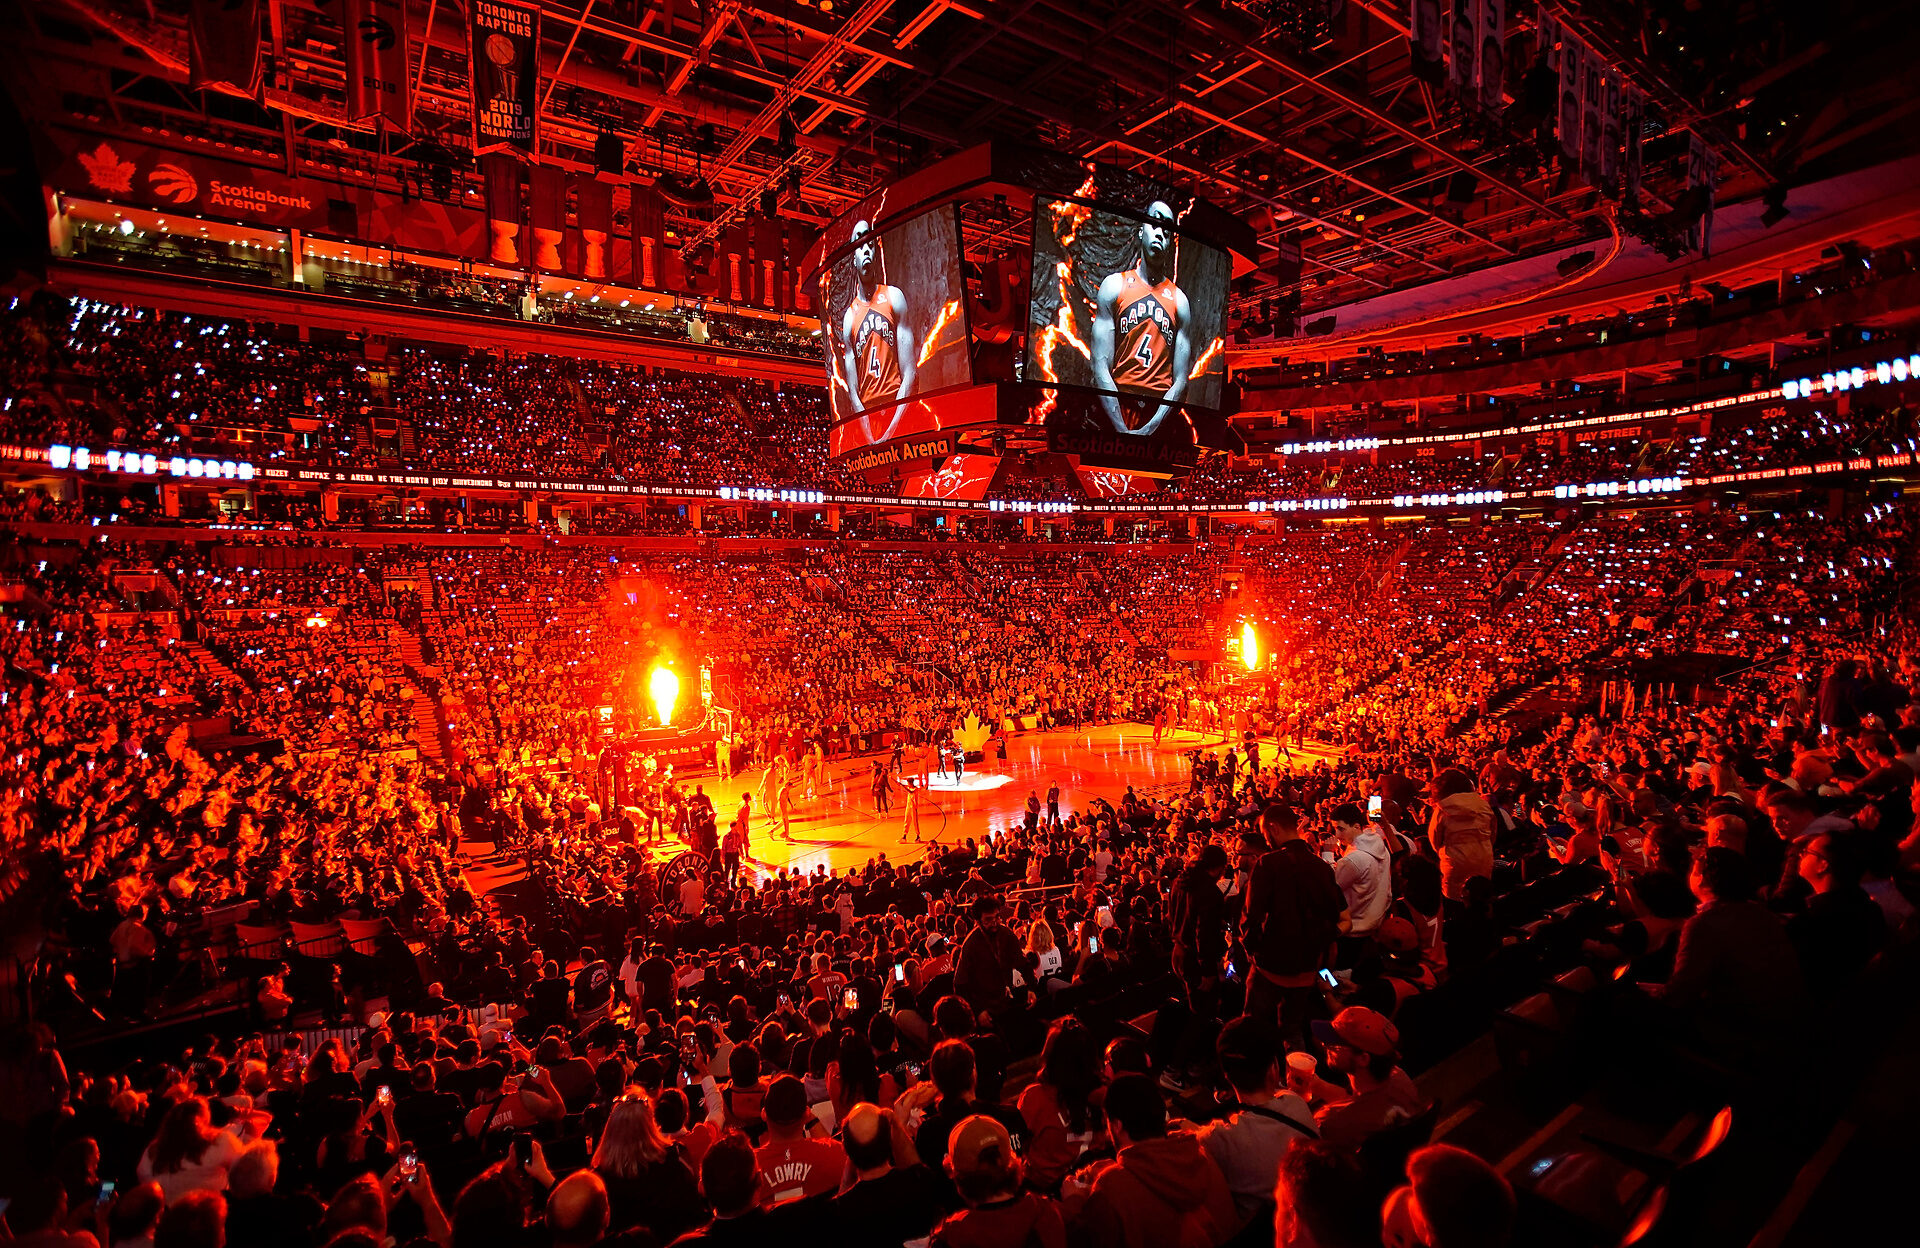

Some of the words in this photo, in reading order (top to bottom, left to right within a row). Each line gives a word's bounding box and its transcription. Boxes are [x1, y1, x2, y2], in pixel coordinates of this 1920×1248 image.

[476, 1, 531, 25] TORONTO
[476, 14, 531, 38] RAPTORS
[489, 98, 523, 116] 2019
[480, 110, 531, 130] WORLD
[480, 124, 531, 139] CHAMPIONS
[211, 180, 311, 210] Scotiabank
[211, 193, 267, 213] Arena
[1119, 301, 1175, 346] RAPTORS
[856, 313, 896, 360] RAPTORS
[869, 345, 882, 378] 4
[1135, 334, 1154, 369] 4
[1056, 431, 1155, 461] Scotiabank
[1576, 432, 1598, 443] BAY
[1600, 427, 1641, 440] STREET
[106, 449, 157, 474] THE
[171, 456, 253, 480] NORTH
[846, 446, 900, 474] Scotiabank
[903, 438, 948, 461] Arena
[1247, 458, 1263, 467] 301
[1416, 448, 1435, 457] 302
[1815, 461, 1843, 473] NORTH
[389, 475, 404, 484] THE
[405, 476, 429, 485] NORTH
[515, 481, 538, 489] NORTH
[550, 482, 563, 490] THE
[1586, 481, 1618, 497] THE
[1627, 476, 1682, 494] LOYAL
[666, 856, 709, 886] TORONTO
[1427, 917, 1438, 947] 7
[763, 1162, 812, 1188] LOWRY
